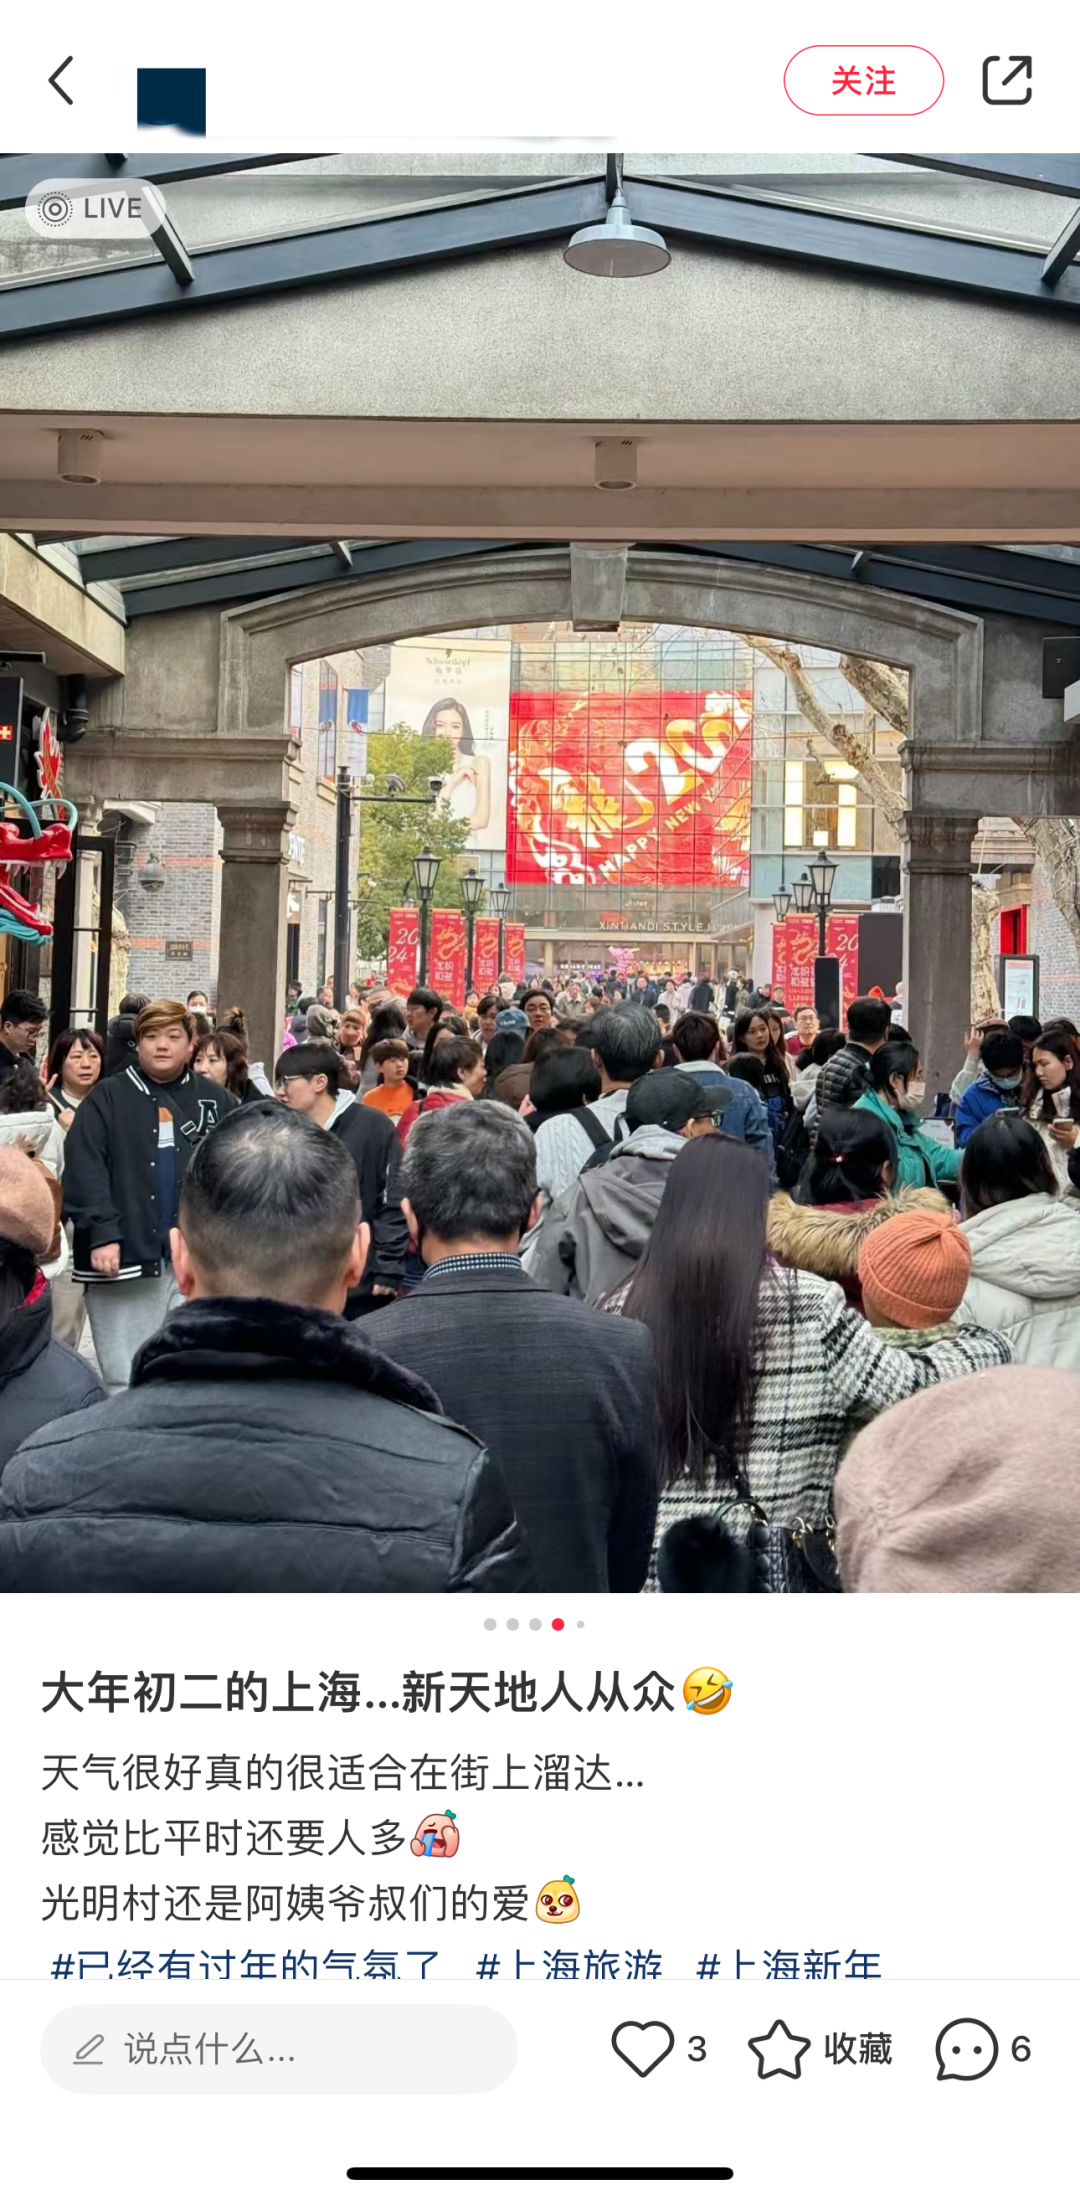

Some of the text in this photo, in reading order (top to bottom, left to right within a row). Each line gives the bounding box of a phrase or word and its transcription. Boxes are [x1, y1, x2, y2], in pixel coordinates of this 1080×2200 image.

[599, 827, 661, 877] HAPPY
[664, 800, 702, 831] NEW
[599, 921, 659, 932] XINTIANDI
[662, 922, 703, 932] STYLE
